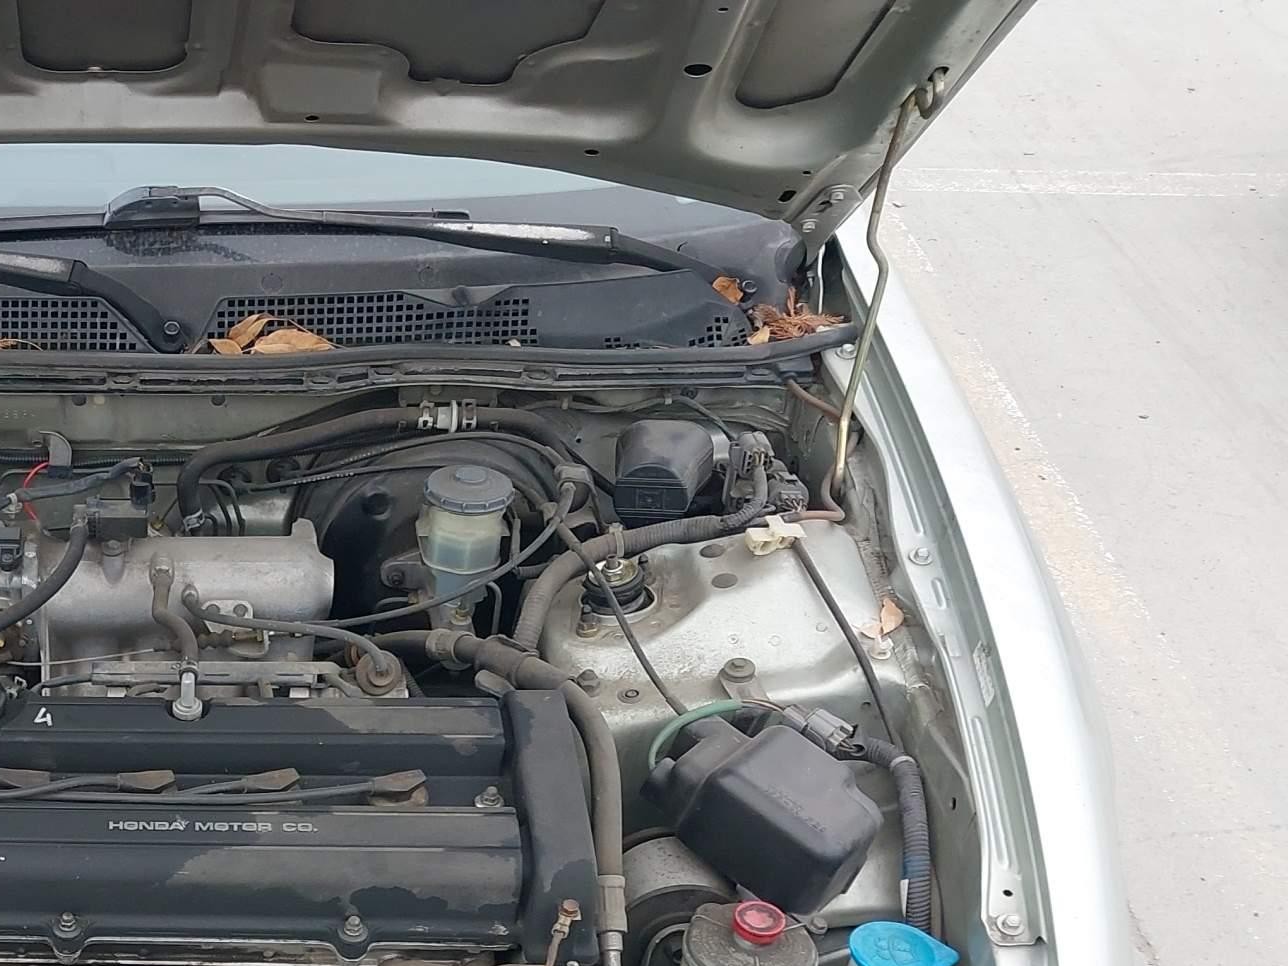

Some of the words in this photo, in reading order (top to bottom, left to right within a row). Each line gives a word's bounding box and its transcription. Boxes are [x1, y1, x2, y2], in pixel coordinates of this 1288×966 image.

[33, 706, 53, 727] 4
[108, 820, 184, 831] HONDA
[194, 821, 273, 832] MOTOR
[281, 822, 319, 832] CO.
